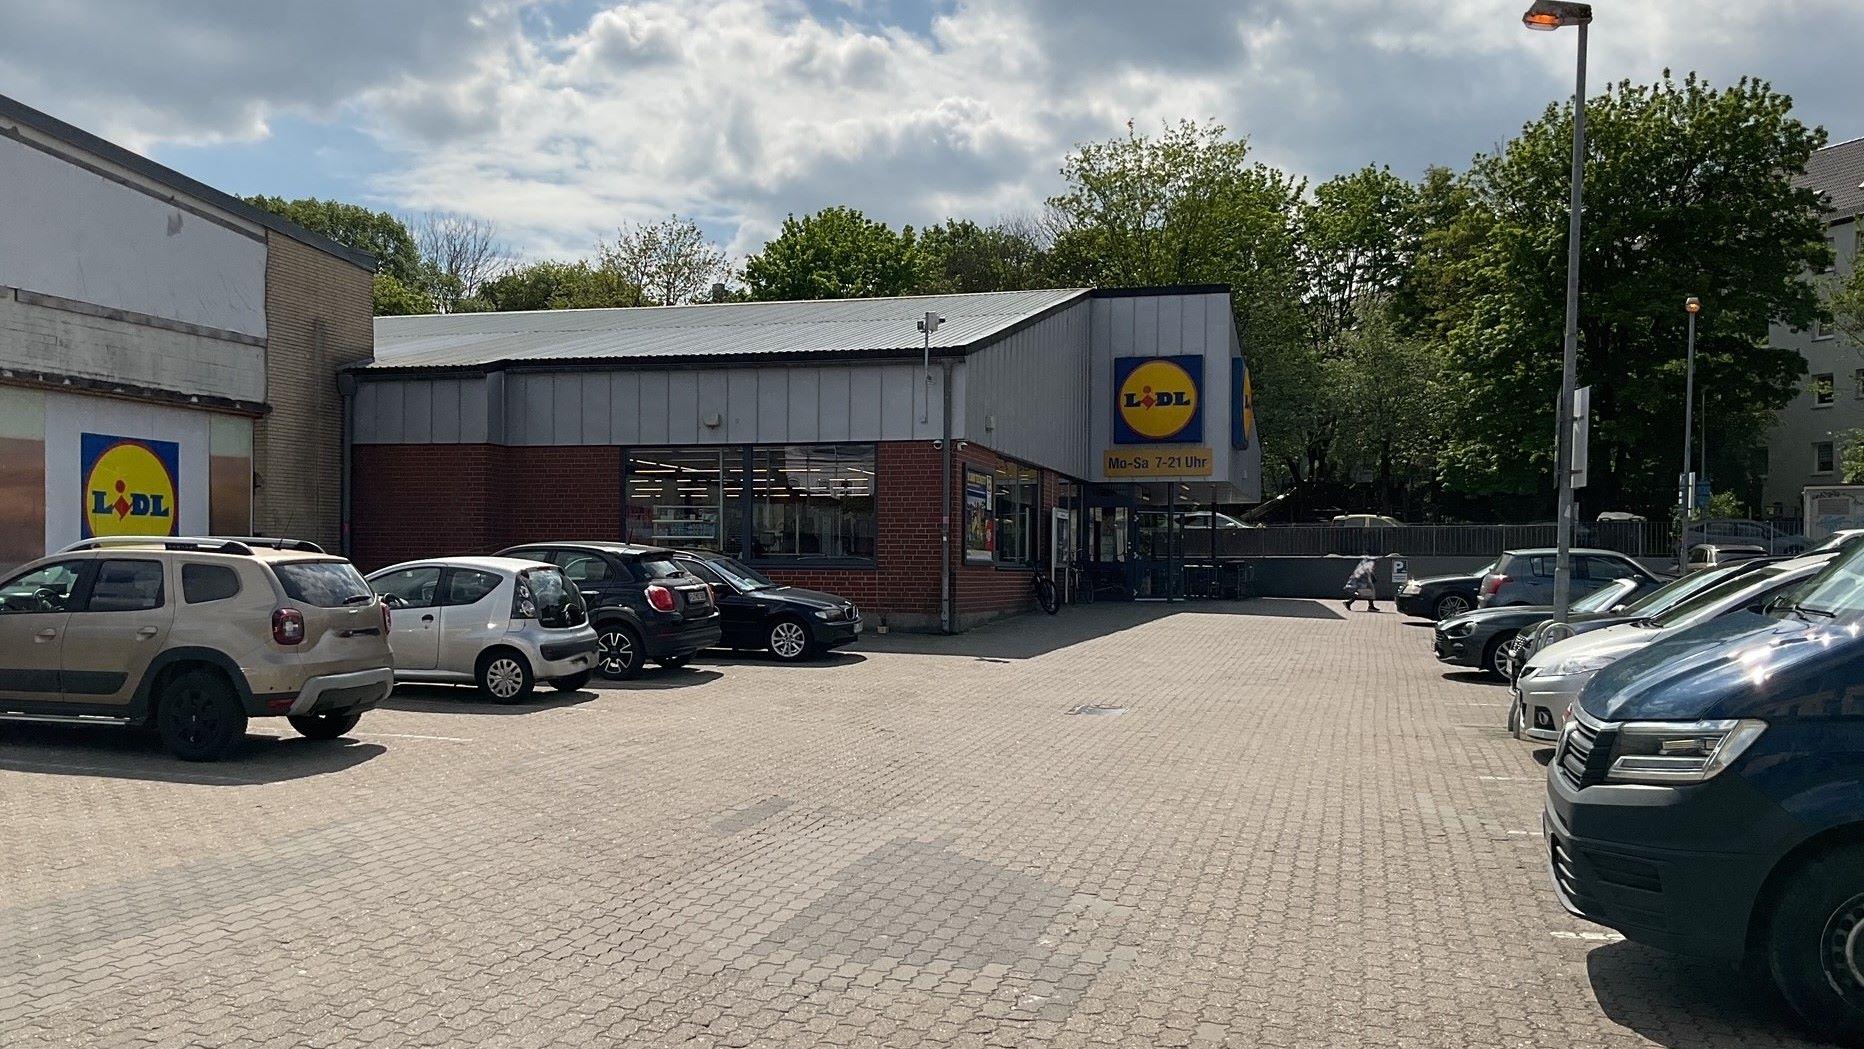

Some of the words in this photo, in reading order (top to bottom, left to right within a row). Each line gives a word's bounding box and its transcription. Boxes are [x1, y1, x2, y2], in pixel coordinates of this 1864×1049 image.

[1108, 456, 1149, 469] Mo-Sa
[1155, 457, 1181, 468] 7-21
[1185, 456, 1208, 468] Uhr
[1393, 561, 1404, 573] P
